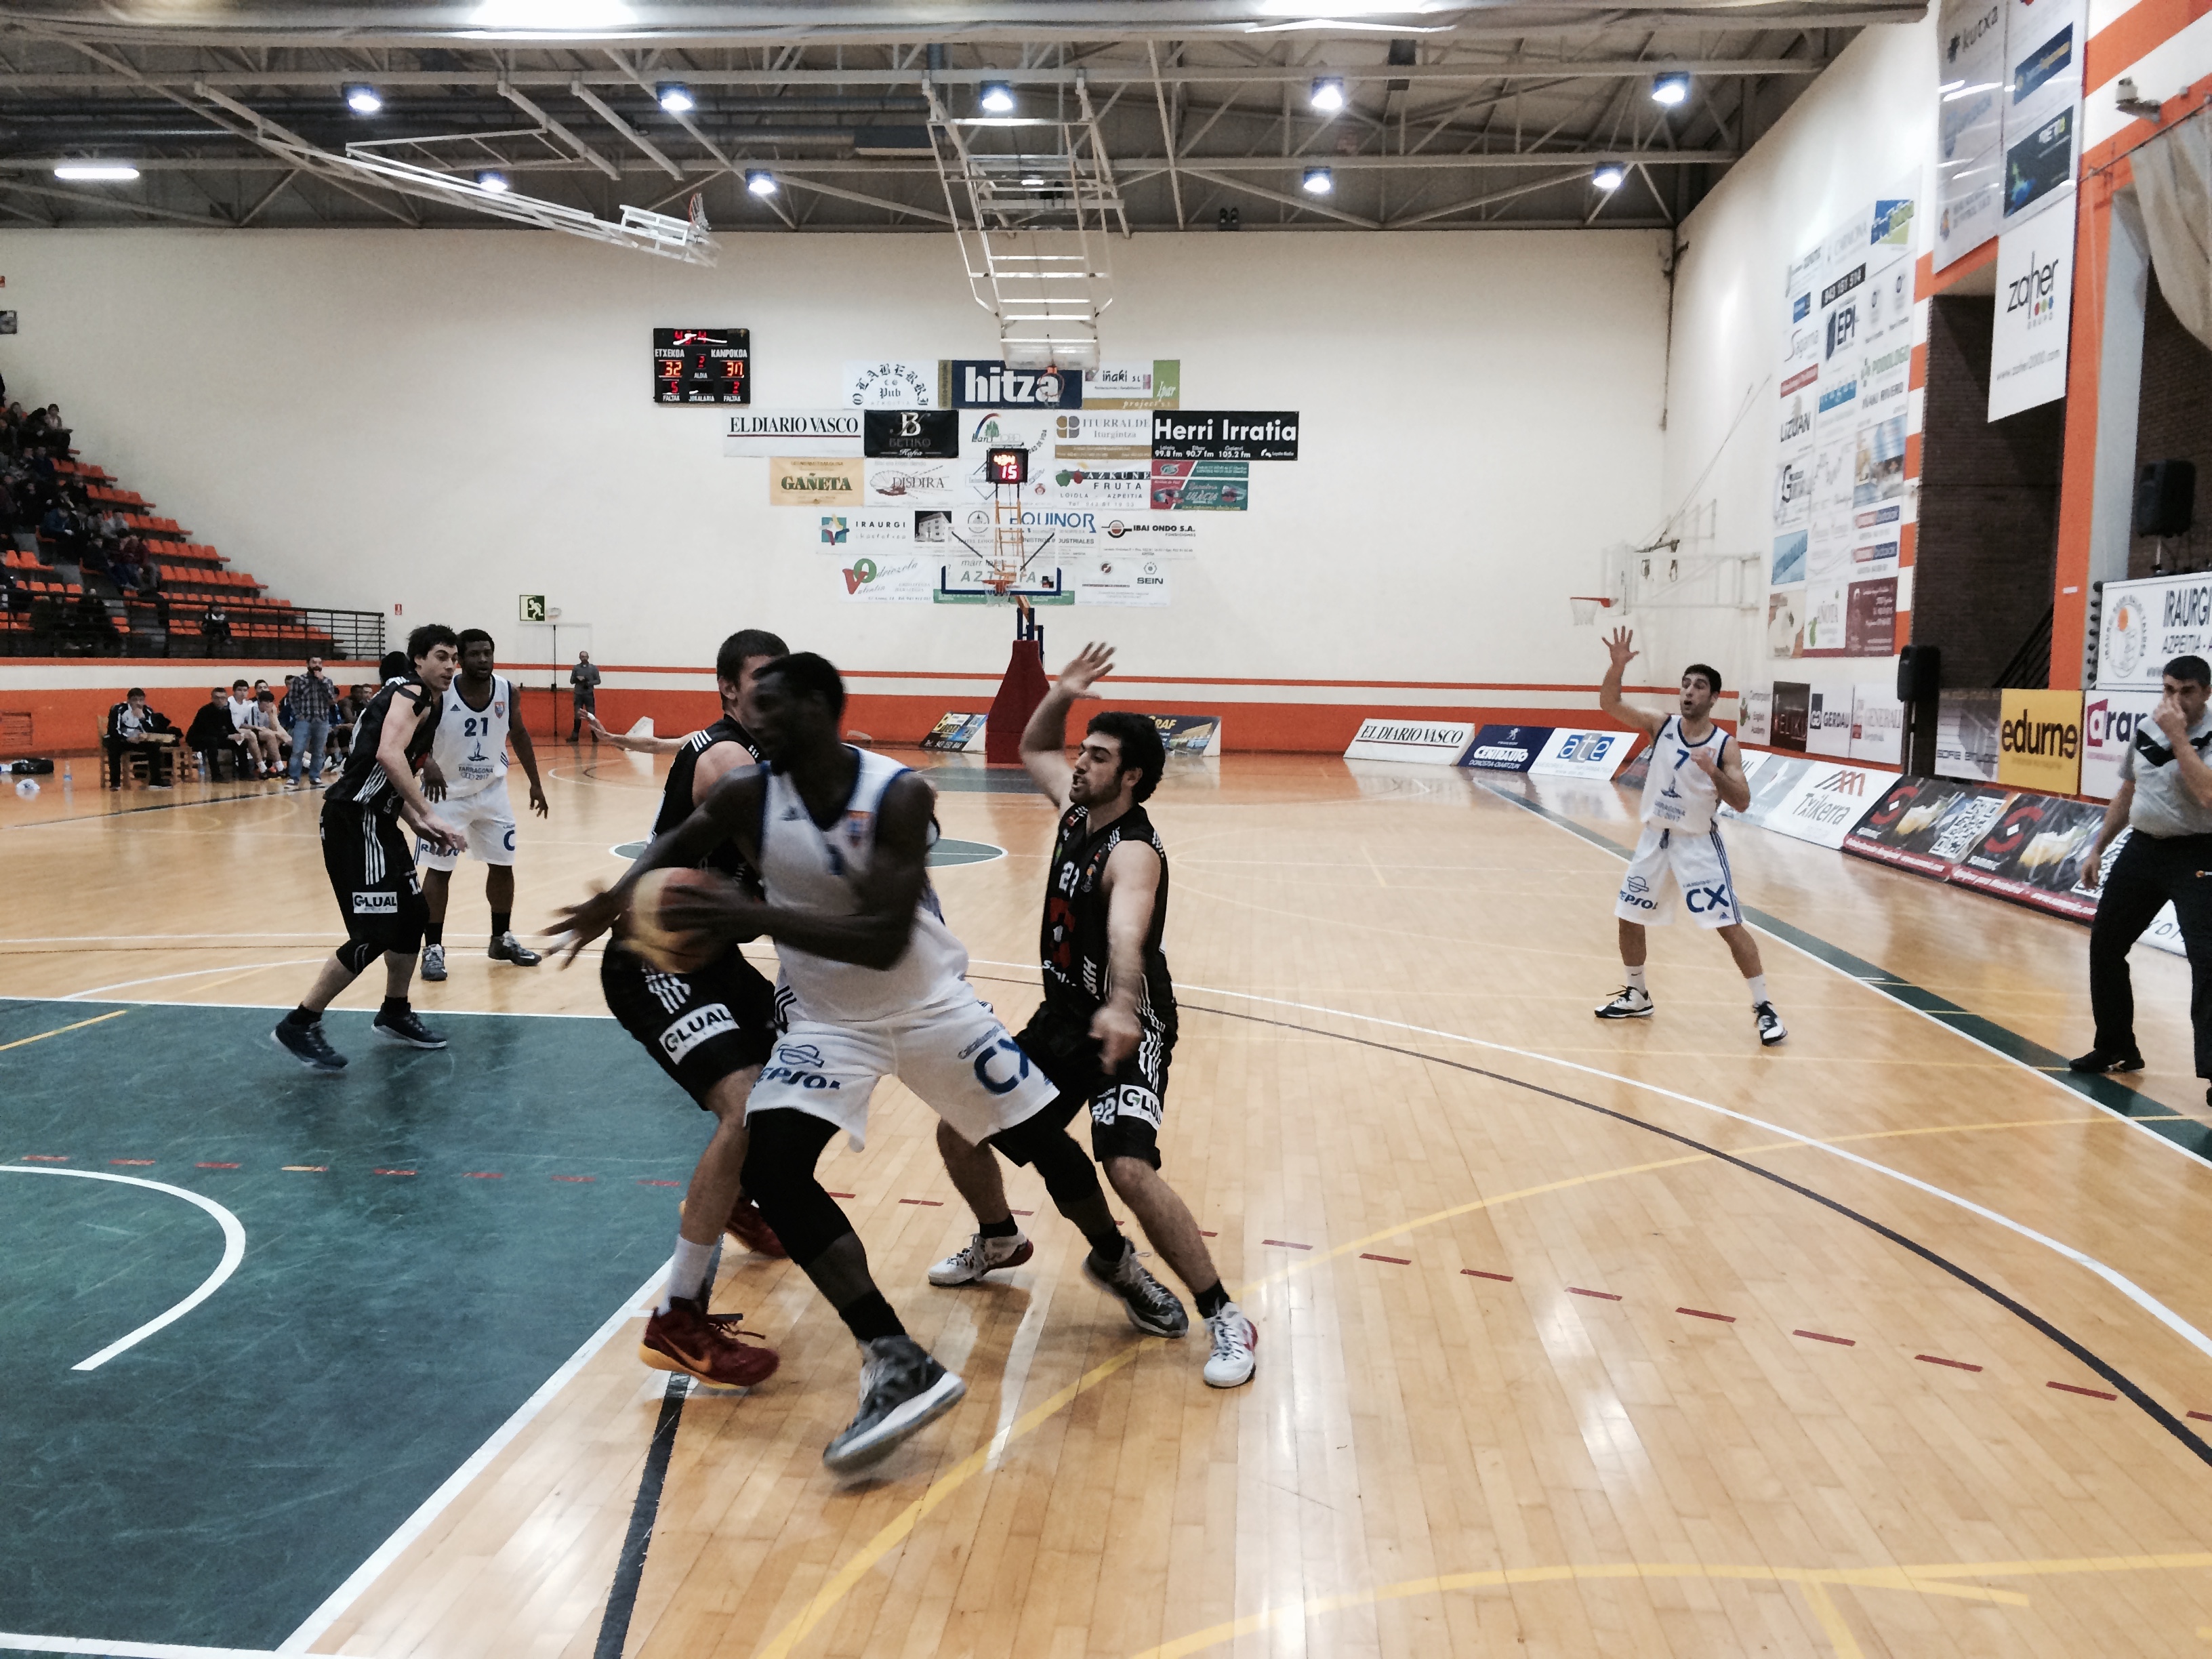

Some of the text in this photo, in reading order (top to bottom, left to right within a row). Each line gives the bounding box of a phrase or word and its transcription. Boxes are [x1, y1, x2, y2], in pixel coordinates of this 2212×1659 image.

[1962, 5, 1999, 52] kutxa
[2007, 251, 2059, 319] zaher
[655, 349, 684, 357] ETXEKOA
[711, 349, 747, 358] KANPOKOA
[665, 361, 682, 376] 32
[698, 356, 705, 369] 2
[671, 381, 678, 394] 5
[733, 381, 740, 394] 2
[965, 367, 1060, 403] hitza
[880, 388, 901, 399] Pub
[730, 417, 859, 434] EL DIARIO VASCO
[1083, 418, 1151, 428] ITURRALDE
[1155, 418, 1296, 441] Herri Irratia
[889, 438, 931, 447] BETIKO
[1002, 464, 1018, 480] 15
[1087, 472, 1151, 480] AZKUNE
[781, 473, 853, 491] GAÑETA
[893, 476, 945, 489] DISDIRA
[464, 717, 489, 737] 21
[1823, 712, 1851, 728] GERDAU
[1360, 725, 1464, 744] EL DIARIO VASCO
[2001, 709, 2078, 759] edurne
[1559, 735, 1610, 761] ate
[1674, 748, 1690, 771] 7
[1793, 793, 1851, 825] Txikerra
[354, 895, 397, 908] GLUAL
[1686, 884, 1729, 913] CX
[664, 1008, 733, 1053] GLUAL
